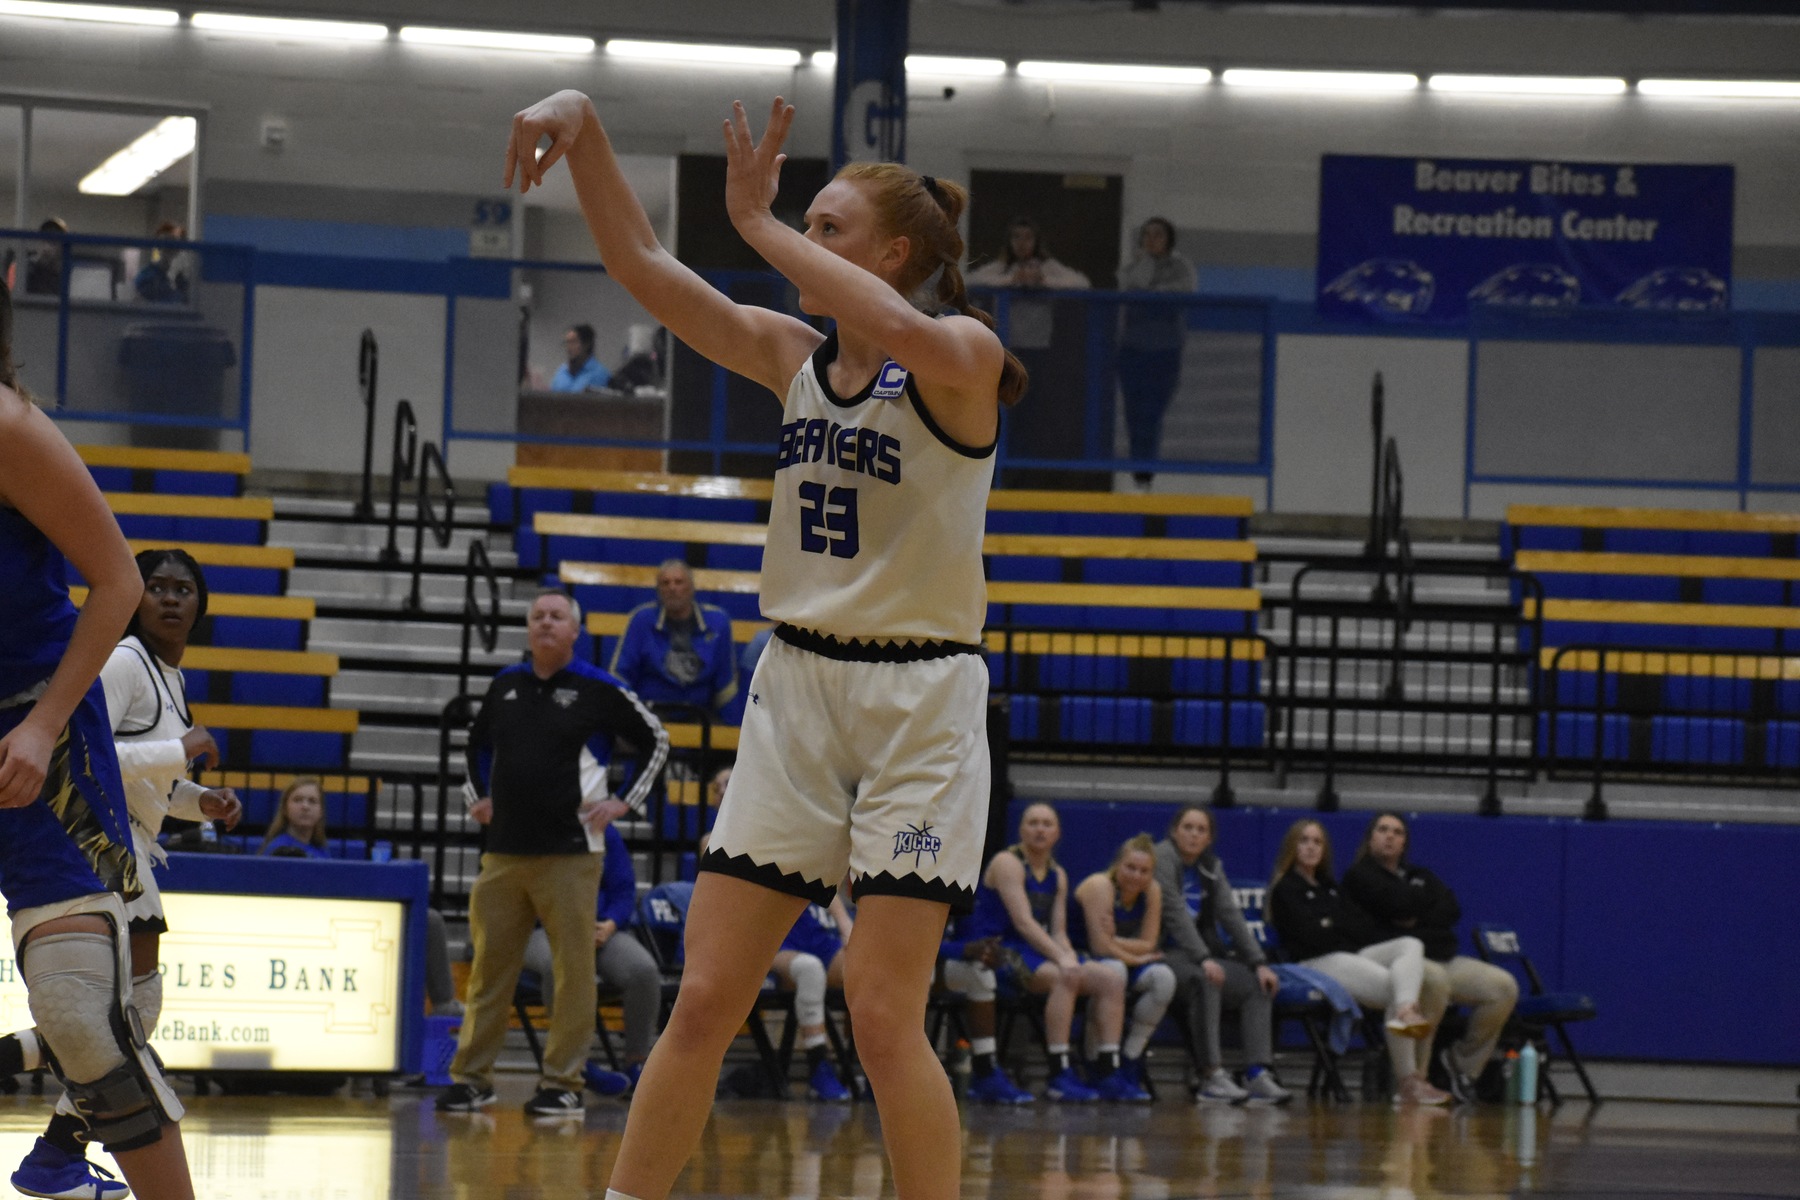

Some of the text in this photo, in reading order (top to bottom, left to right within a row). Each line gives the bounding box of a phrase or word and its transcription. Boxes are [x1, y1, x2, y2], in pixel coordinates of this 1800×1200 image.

[1415, 161, 1638, 197] Beaver Bites &
[1393, 204, 1659, 241] Recreation Center
[776, 418, 901, 486] BEAVERS
[798, 480, 860, 559] 23
[268, 958, 358, 992] BANK
